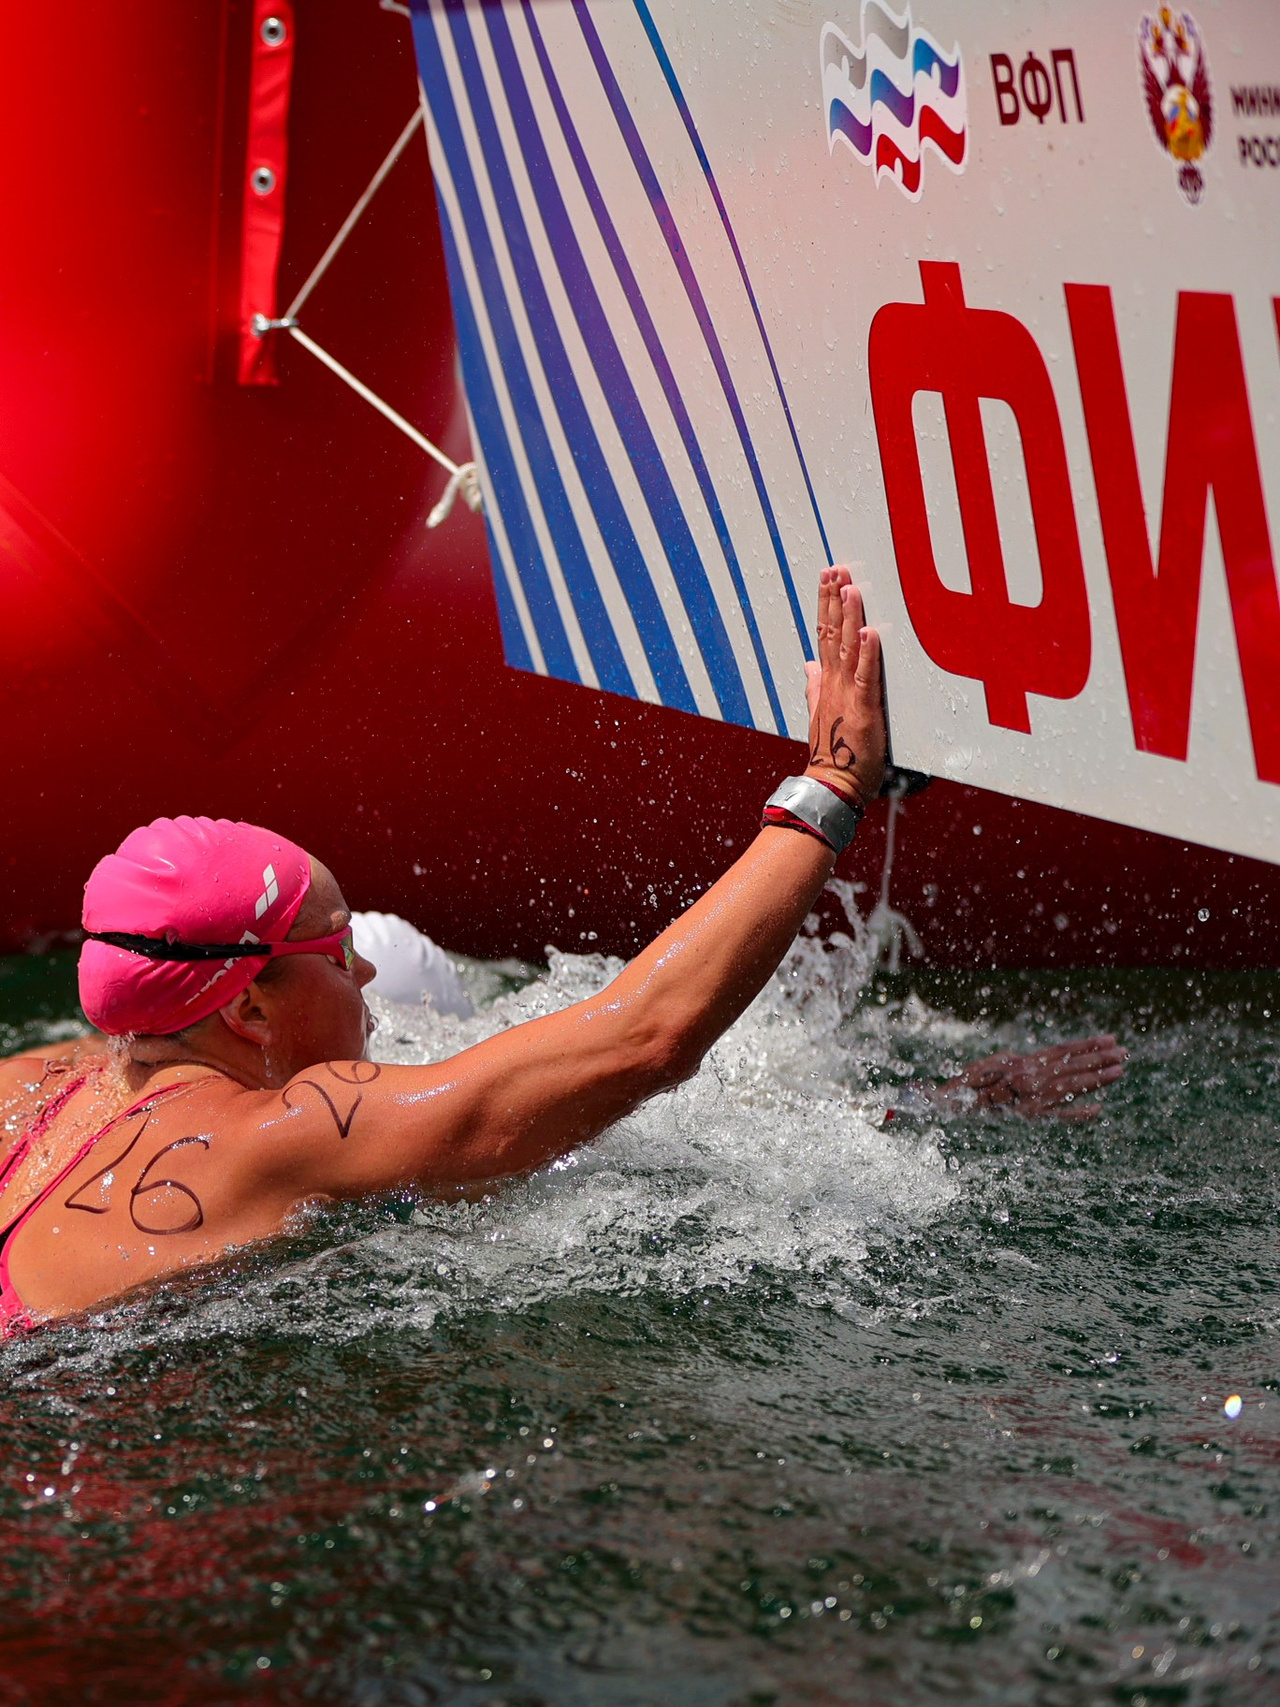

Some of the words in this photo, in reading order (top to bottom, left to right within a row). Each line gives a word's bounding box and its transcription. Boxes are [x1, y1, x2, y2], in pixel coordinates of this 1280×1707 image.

[989, 48, 1086, 127] ВФП
[1238, 134, 1280, 169] РОС
[867, 259, 1280, 787] ФИ
[64, 1107, 210, 1236] 26
